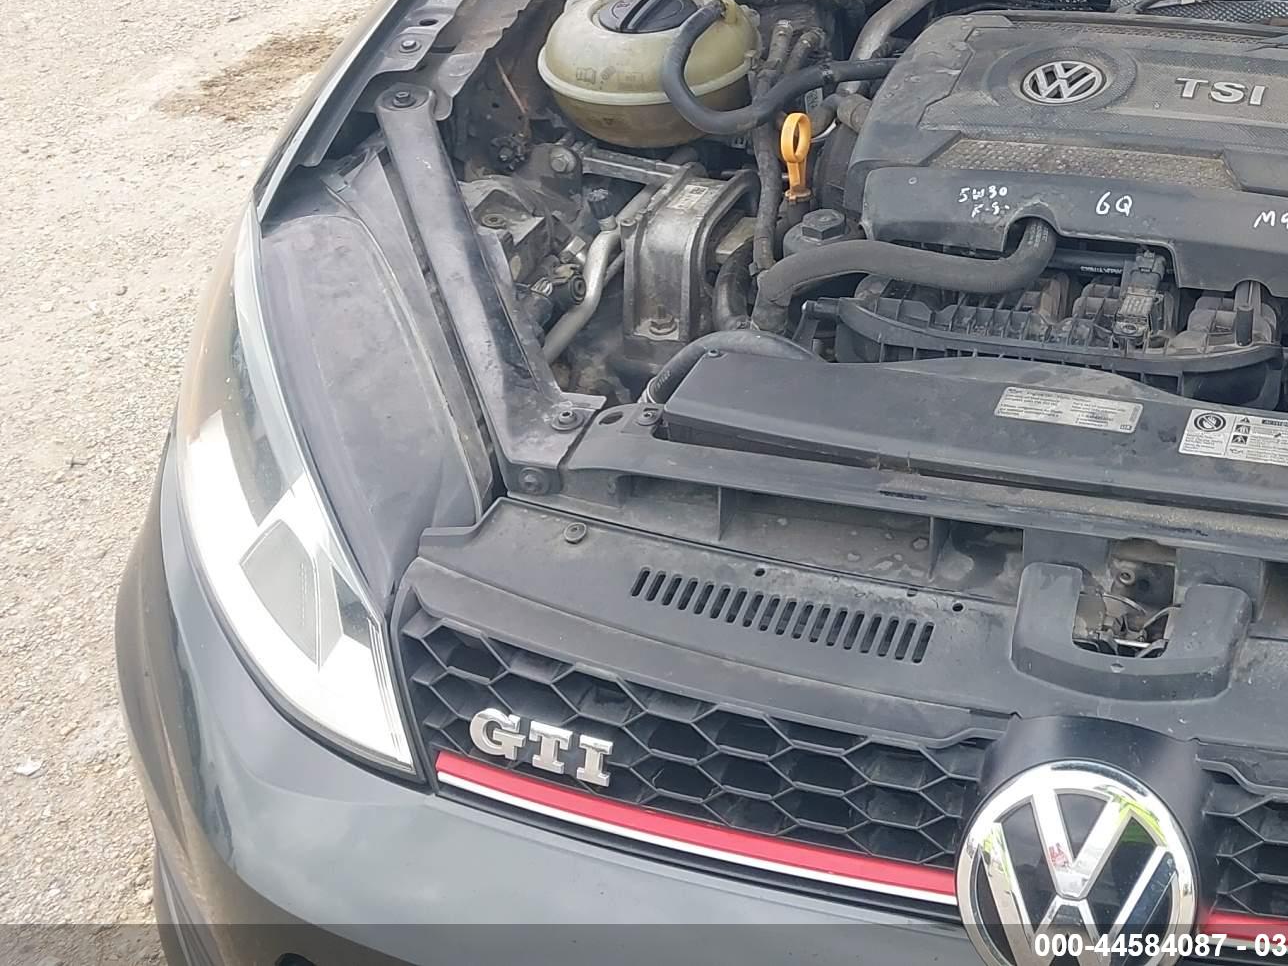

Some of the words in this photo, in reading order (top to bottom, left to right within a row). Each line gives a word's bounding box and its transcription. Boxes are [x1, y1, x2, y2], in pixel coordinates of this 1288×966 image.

[1176, 77, 1267, 106] TSI
[1095, 191, 1133, 217] 6Q
[469, 708, 614, 787] GTI
